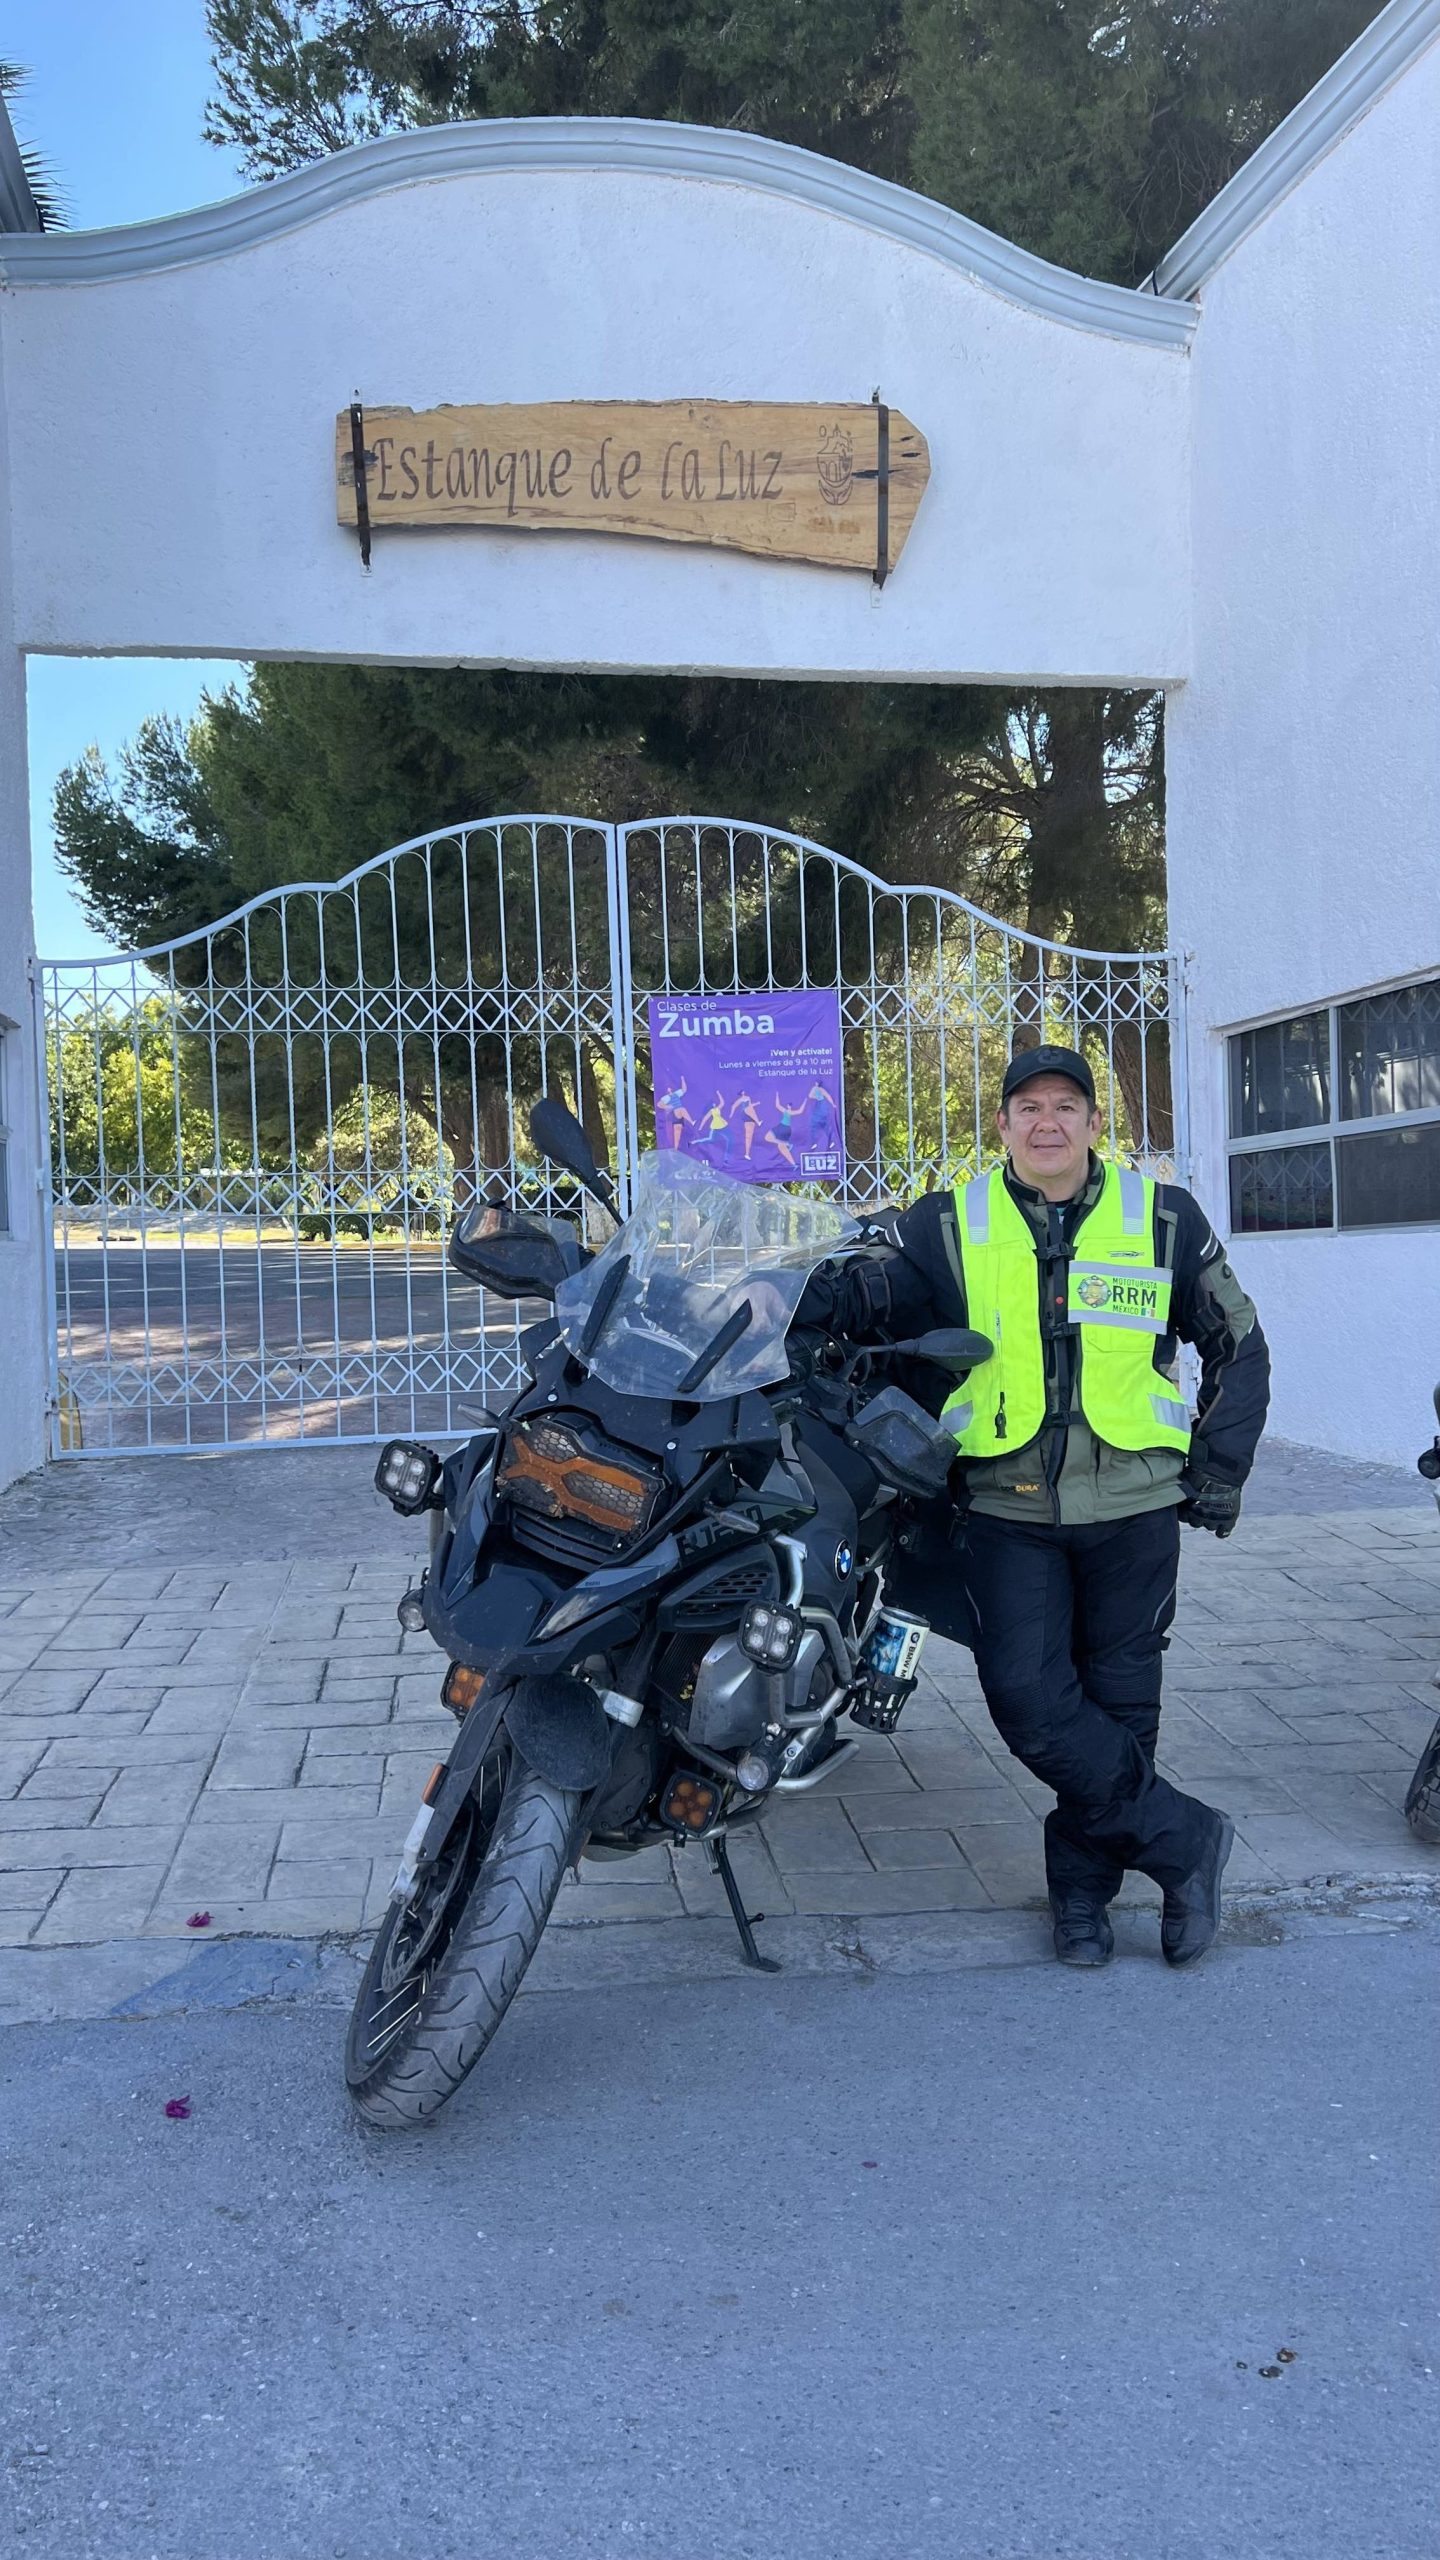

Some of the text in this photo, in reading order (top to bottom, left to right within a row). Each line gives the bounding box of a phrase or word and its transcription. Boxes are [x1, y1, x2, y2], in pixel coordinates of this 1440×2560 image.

[372, 437, 783, 518] Estanque de la Luz
[657, 1000, 717, 1012] Clases de
[658, 1009, 775, 1038] Zumba
[770, 1049, 789, 1057] ¡Ven
[791, 1049, 797, 1057] y
[719, 1061, 743, 1069] Lunes
[752, 1060, 781, 1068] viernes
[783, 1059, 794, 1067] de
[758, 1067, 833, 1078] Estanque de la Luz
[1113, 1277, 1158, 1290] MOTOTURISTA
[1112, 1285, 1157, 1309] RRM
[904, 1646, 916, 1669] BMW
